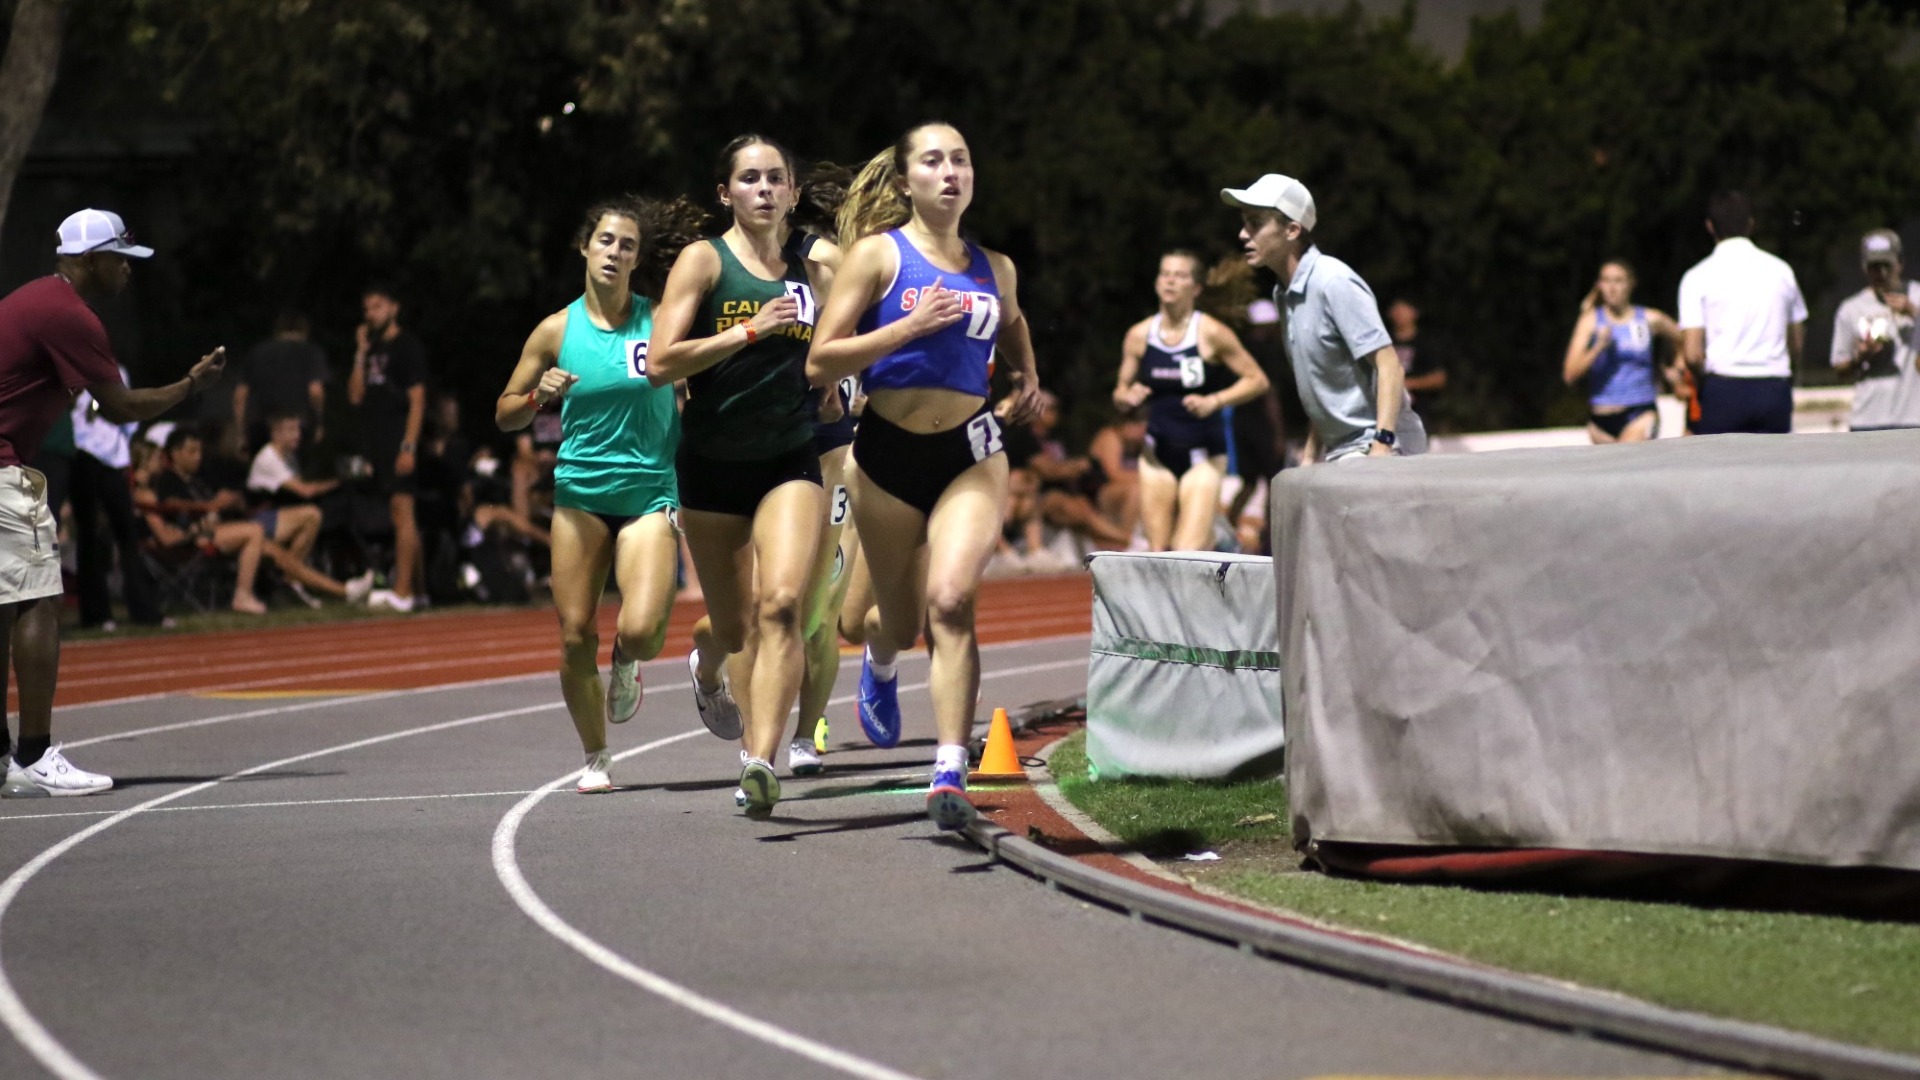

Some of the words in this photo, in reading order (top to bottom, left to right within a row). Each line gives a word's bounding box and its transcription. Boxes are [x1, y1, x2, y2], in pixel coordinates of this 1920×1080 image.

[792, 285, 807, 318] 1
[975, 295, 993, 336] 7
[633, 342, 647, 376] 6
[972, 417, 993, 456] 7
[834, 487, 848, 523] 3
[863, 702, 893, 740] BROOKS
